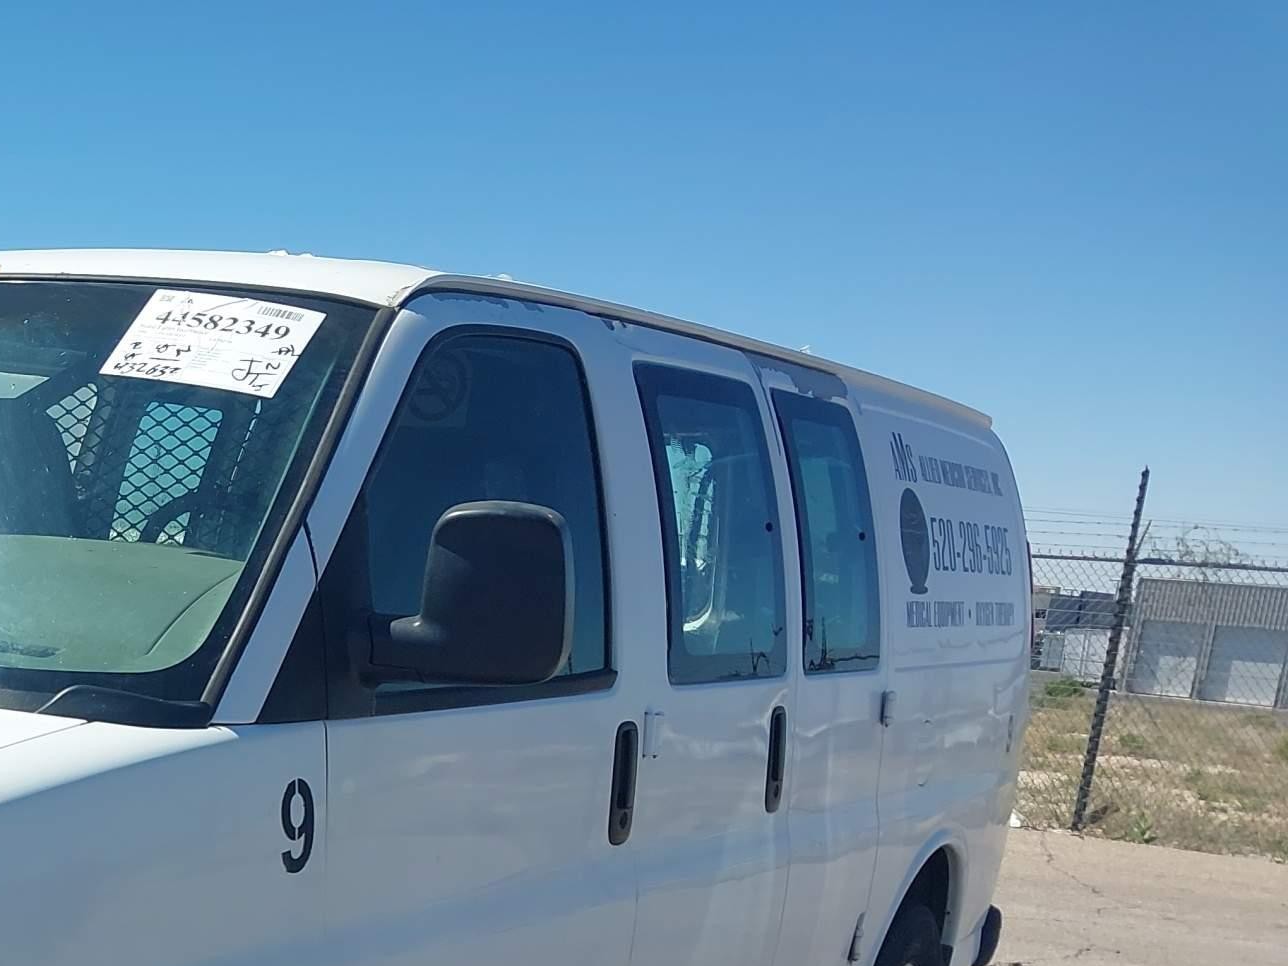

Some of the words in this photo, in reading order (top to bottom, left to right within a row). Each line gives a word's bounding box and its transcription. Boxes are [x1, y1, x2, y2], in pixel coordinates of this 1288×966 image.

[155, 310, 290, 340] 44582349
[889, 431, 918, 483] AMS
[930, 516, 1012, 576] 520-296-5925
[280, 777, 314, 874] 9
